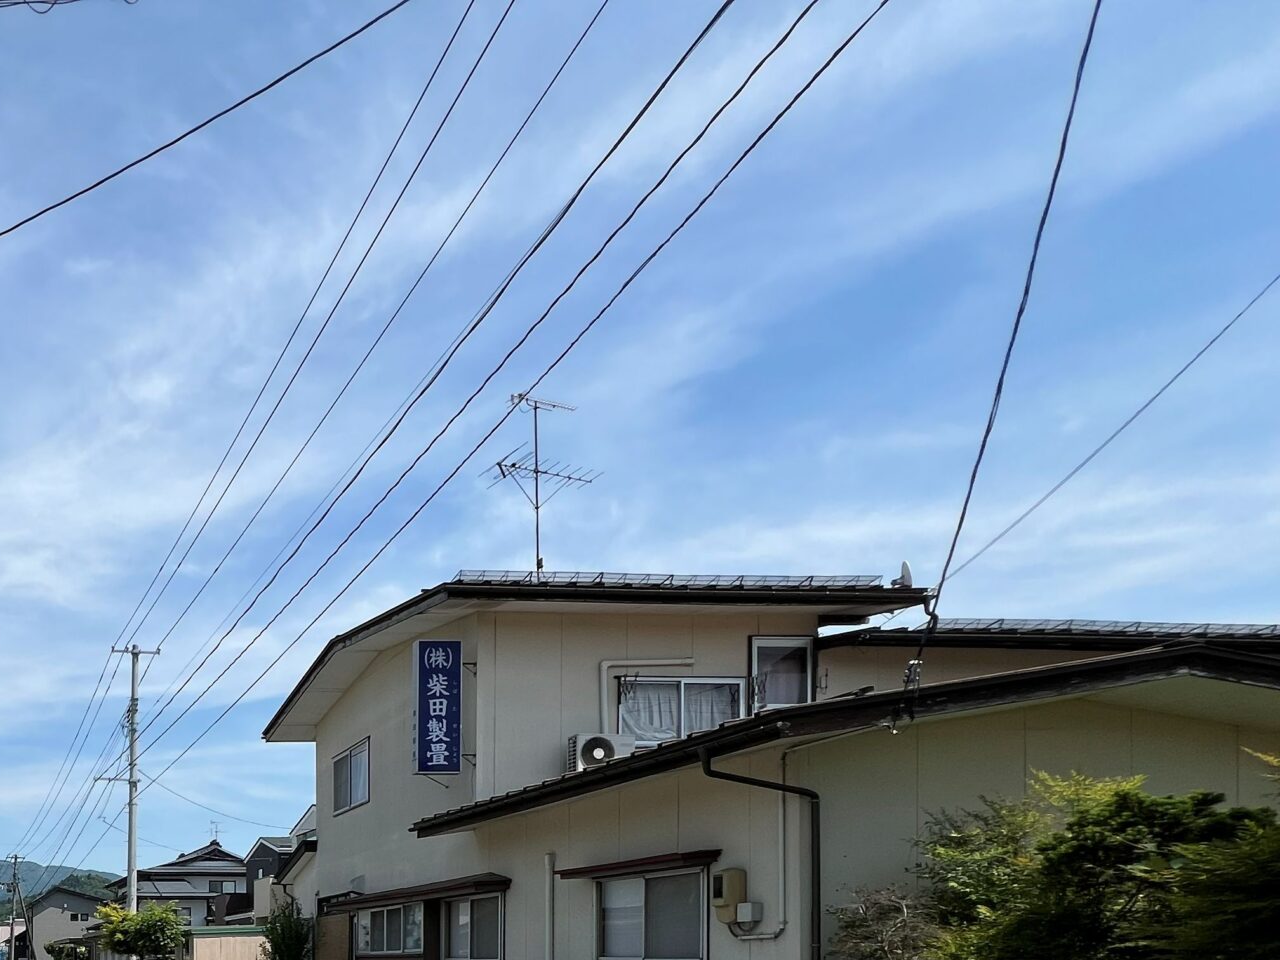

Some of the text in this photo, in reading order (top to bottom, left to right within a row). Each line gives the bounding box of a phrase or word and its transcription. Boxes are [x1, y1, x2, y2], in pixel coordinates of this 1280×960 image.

[424, 647, 453, 766] (株)柴田製畳
